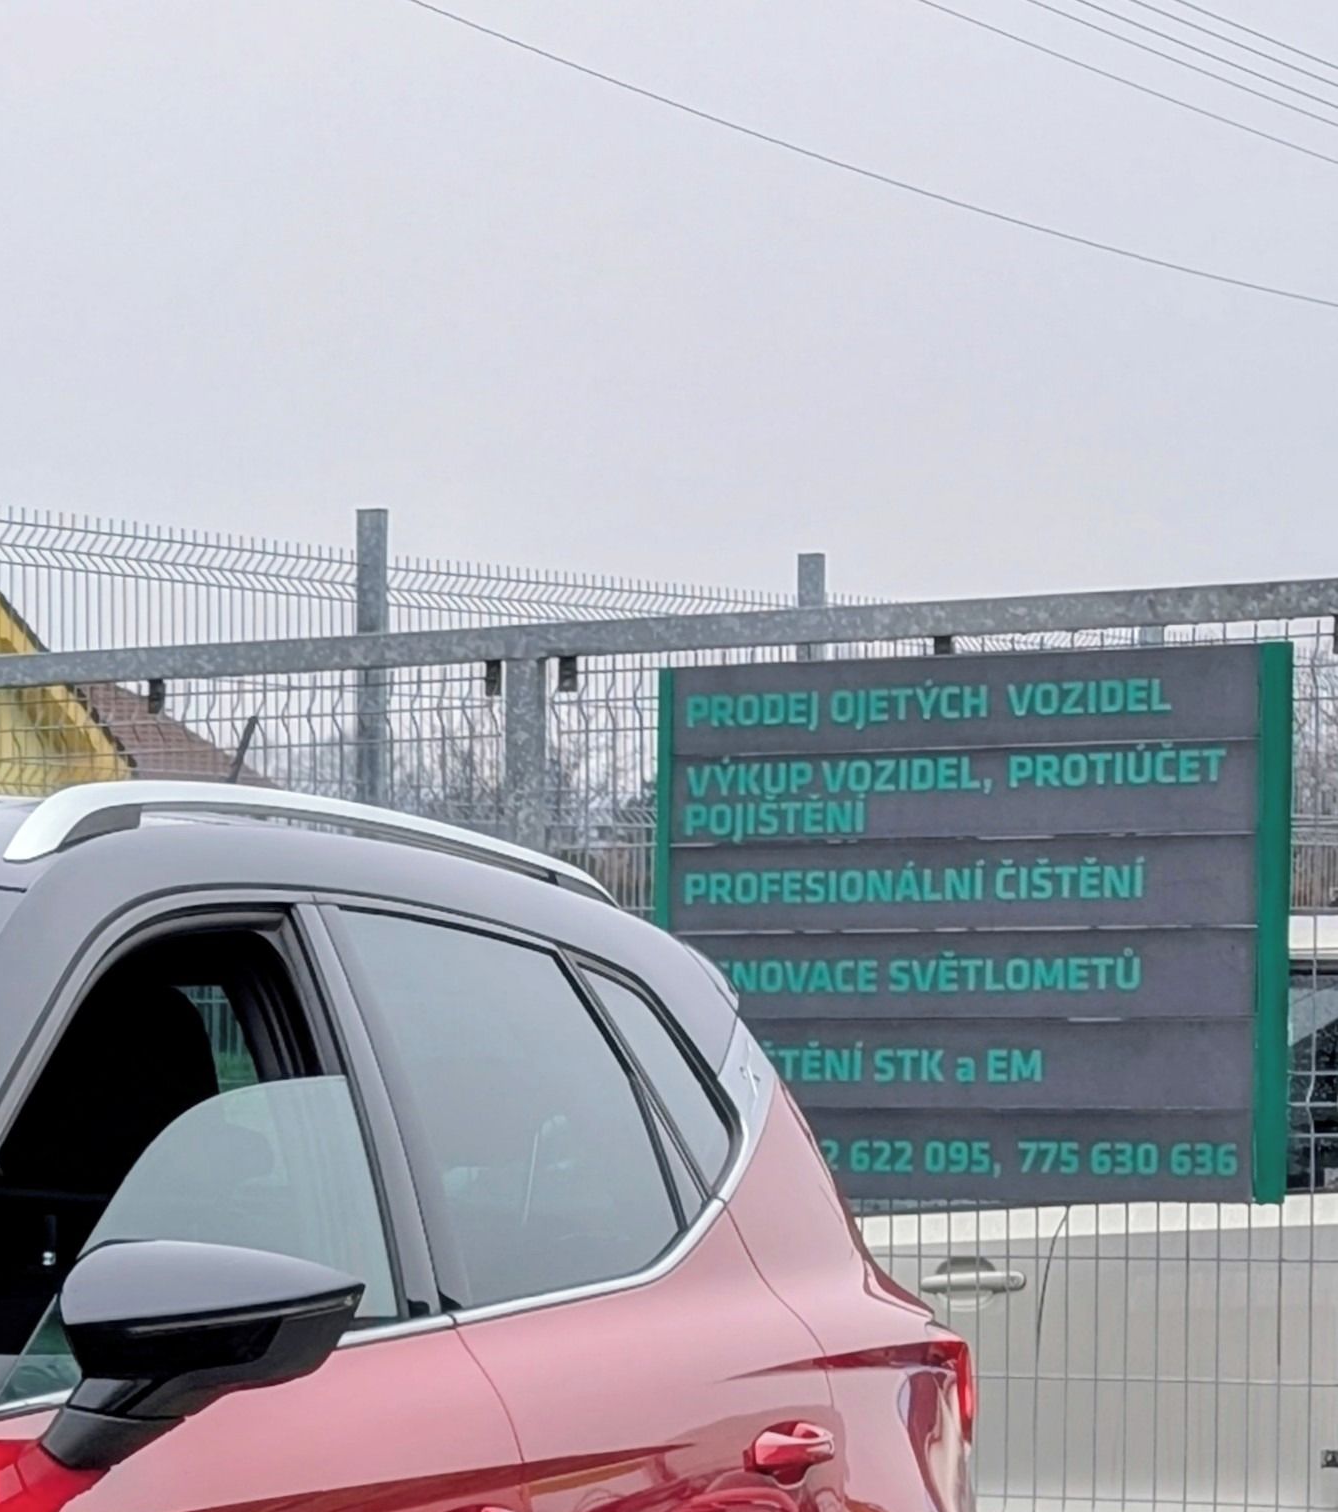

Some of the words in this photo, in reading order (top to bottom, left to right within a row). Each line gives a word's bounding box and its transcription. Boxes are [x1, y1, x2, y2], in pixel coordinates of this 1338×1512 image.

[686, 690, 819, 732] PRODEJ
[830, 678, 988, 731] OJETÝCH
[1007, 678, 1172, 718] VOZIDEL
[686, 755, 813, 798] VÝKUP
[821, 756, 993, 794] VOZIDEL,
[1008, 740, 1227, 788] PROTIÚČET
[683, 793, 866, 842] POJIŠTĚNÍ
[684, 860, 985, 905] PROFESIONÁLNÍ
[994, 859, 1144, 901] ČIŠTĚNÍ
[888, 947, 1142, 993] SVĚTLOMETŮ
[873, 1048, 945, 1082] STK
[955, 1056, 976, 1082] a
[986, 1049, 1043, 1082] EM
[849, 1140, 913, 1173] 622
[924, 1141, 1001, 1178] 095,
[1017, 1142, 1079, 1174] 775
[1090, 1143, 1158, 1175] 630
[1170, 1143, 1238, 1176] 636
